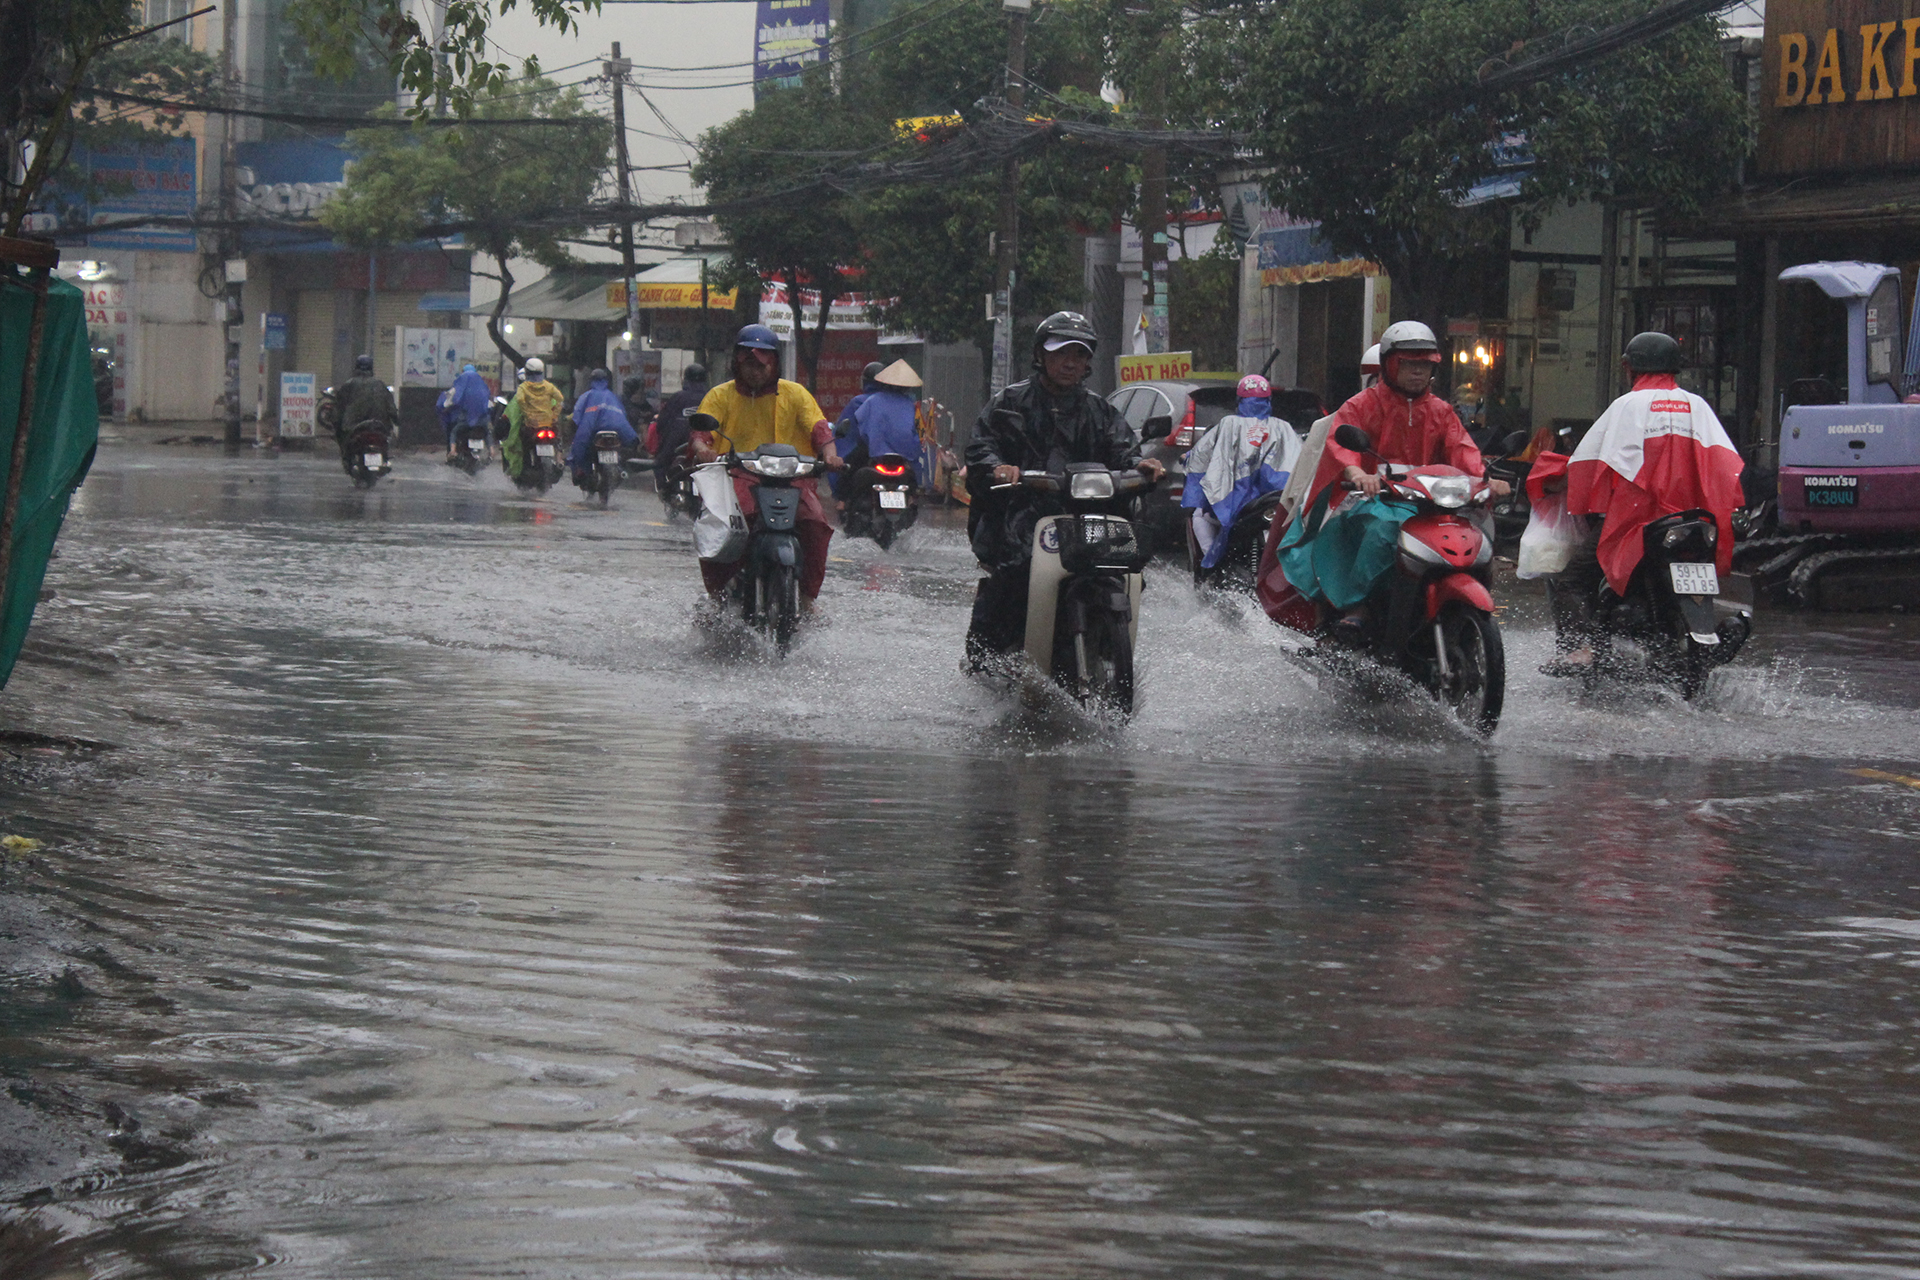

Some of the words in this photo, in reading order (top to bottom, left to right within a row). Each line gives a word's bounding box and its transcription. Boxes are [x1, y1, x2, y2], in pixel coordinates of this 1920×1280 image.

[1159, 357, 1191, 379] HẤP
[1828, 422, 1884, 434] KOMATSU
[1804, 475, 1857, 487] KOMATSU
[1677, 565, 1708, 578] 59-L1
[1675, 579, 1716, 592] 651.85
